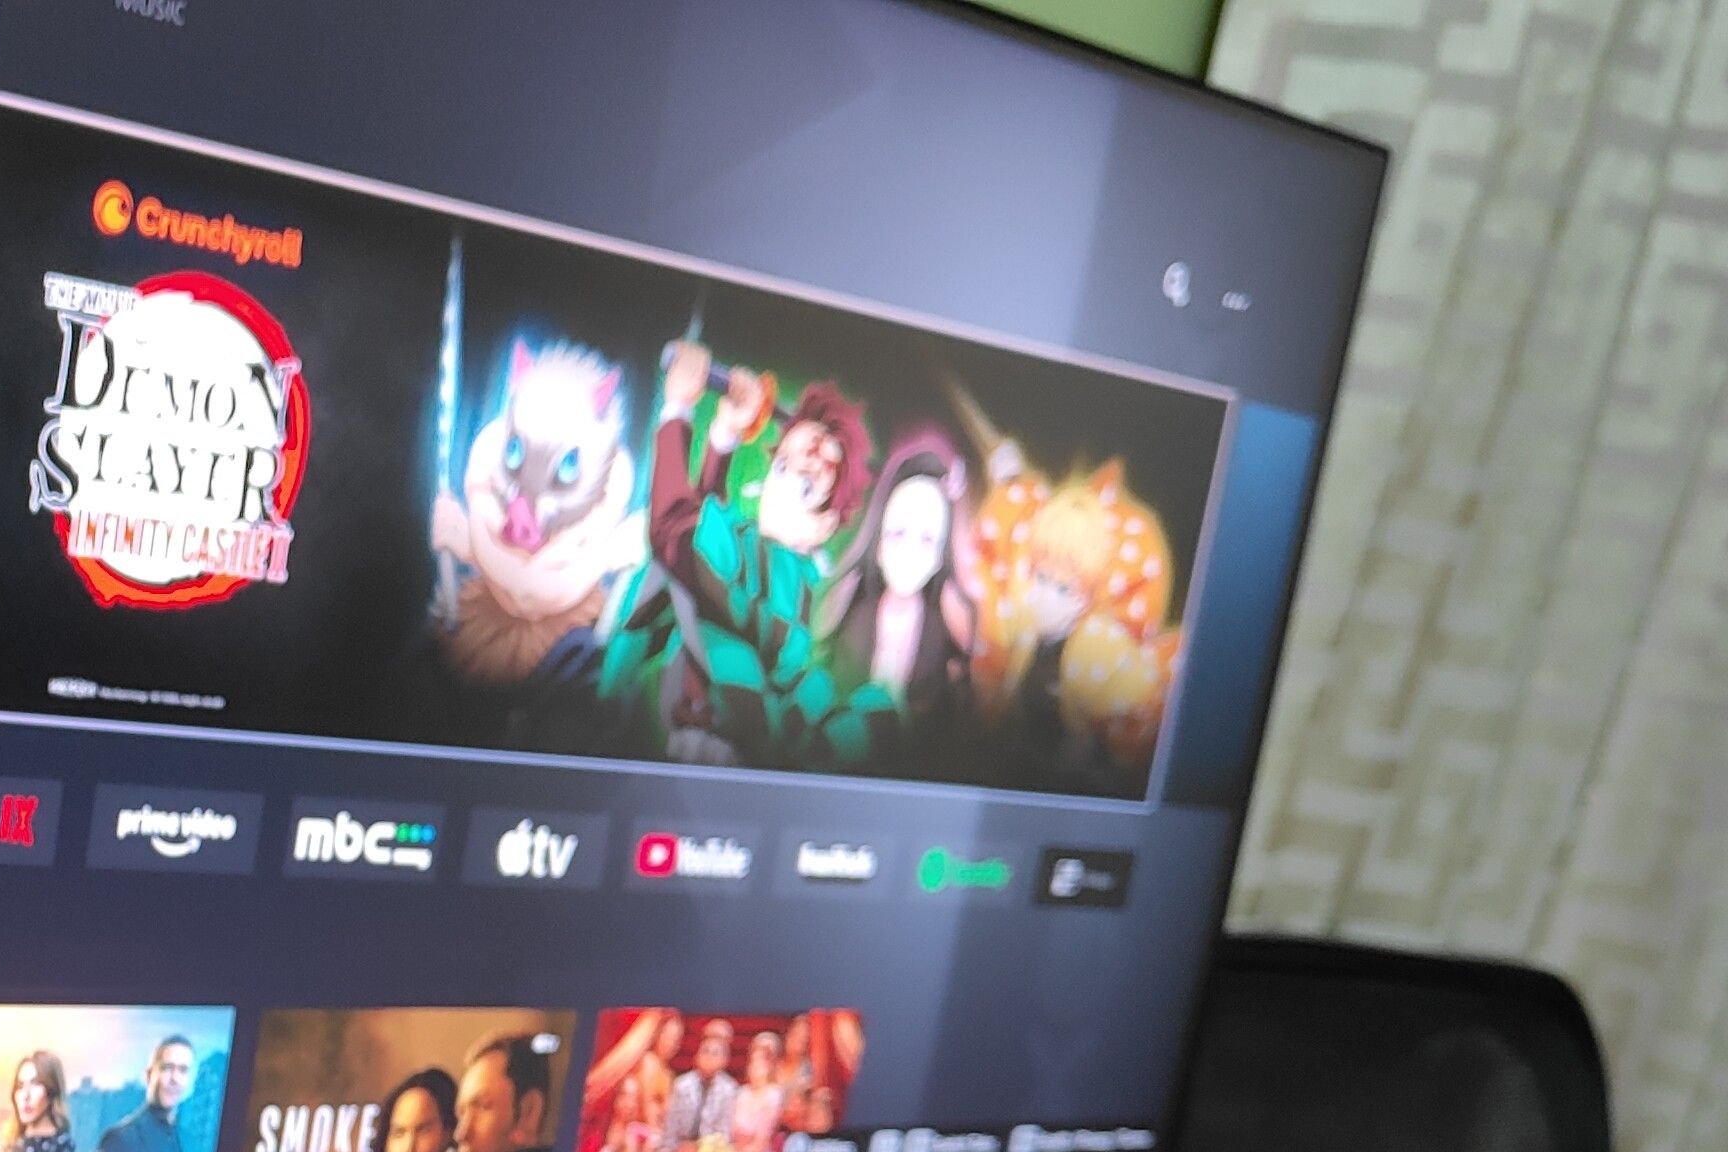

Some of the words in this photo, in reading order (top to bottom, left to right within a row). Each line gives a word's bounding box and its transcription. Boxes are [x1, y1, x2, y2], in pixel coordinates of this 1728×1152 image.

[136, 196, 303, 269] Crunchyroll
[69, 509, 175, 561] INFINITY
[293, 810, 399, 865] mbc
